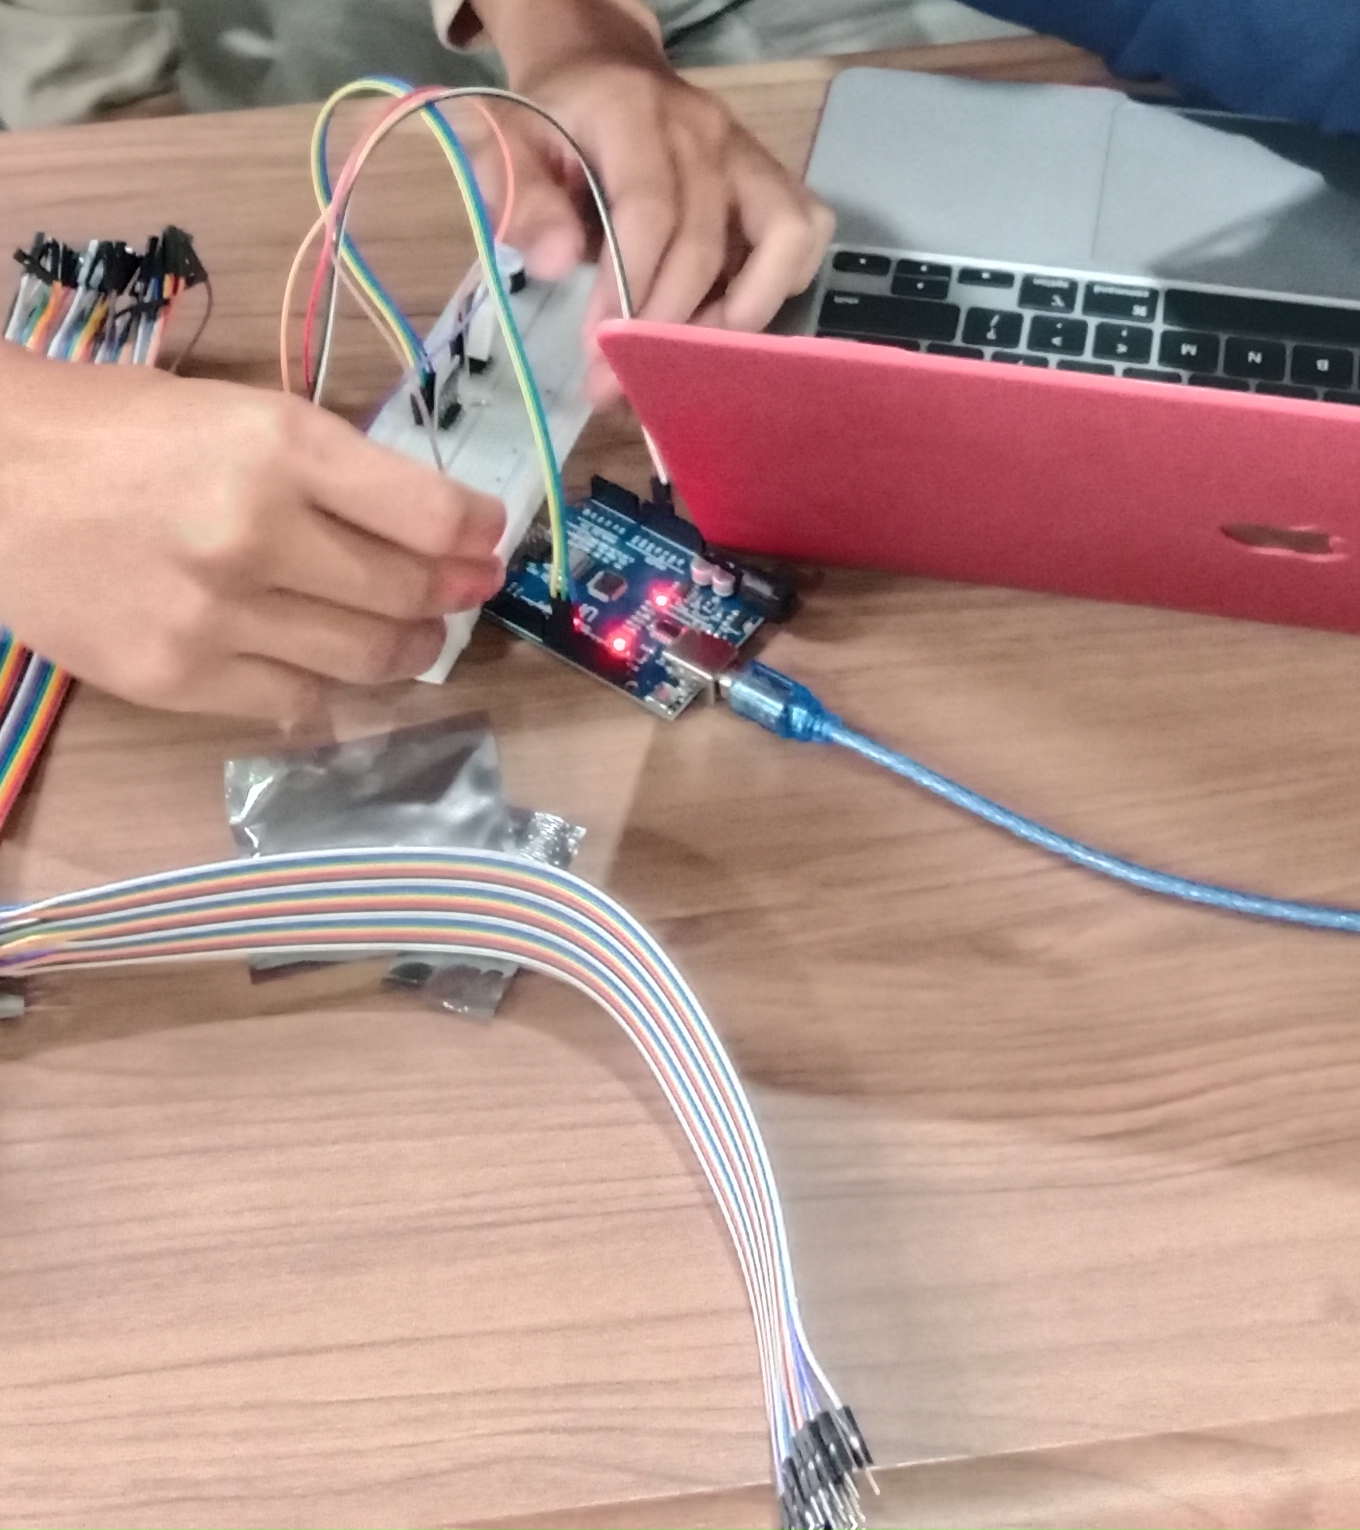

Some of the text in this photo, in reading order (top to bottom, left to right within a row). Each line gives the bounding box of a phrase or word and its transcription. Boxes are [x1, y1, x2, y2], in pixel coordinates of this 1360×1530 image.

[1181, 343, 1197, 357] M
[1247, 350, 1263, 365] N
[1316, 358, 1330, 372] B
